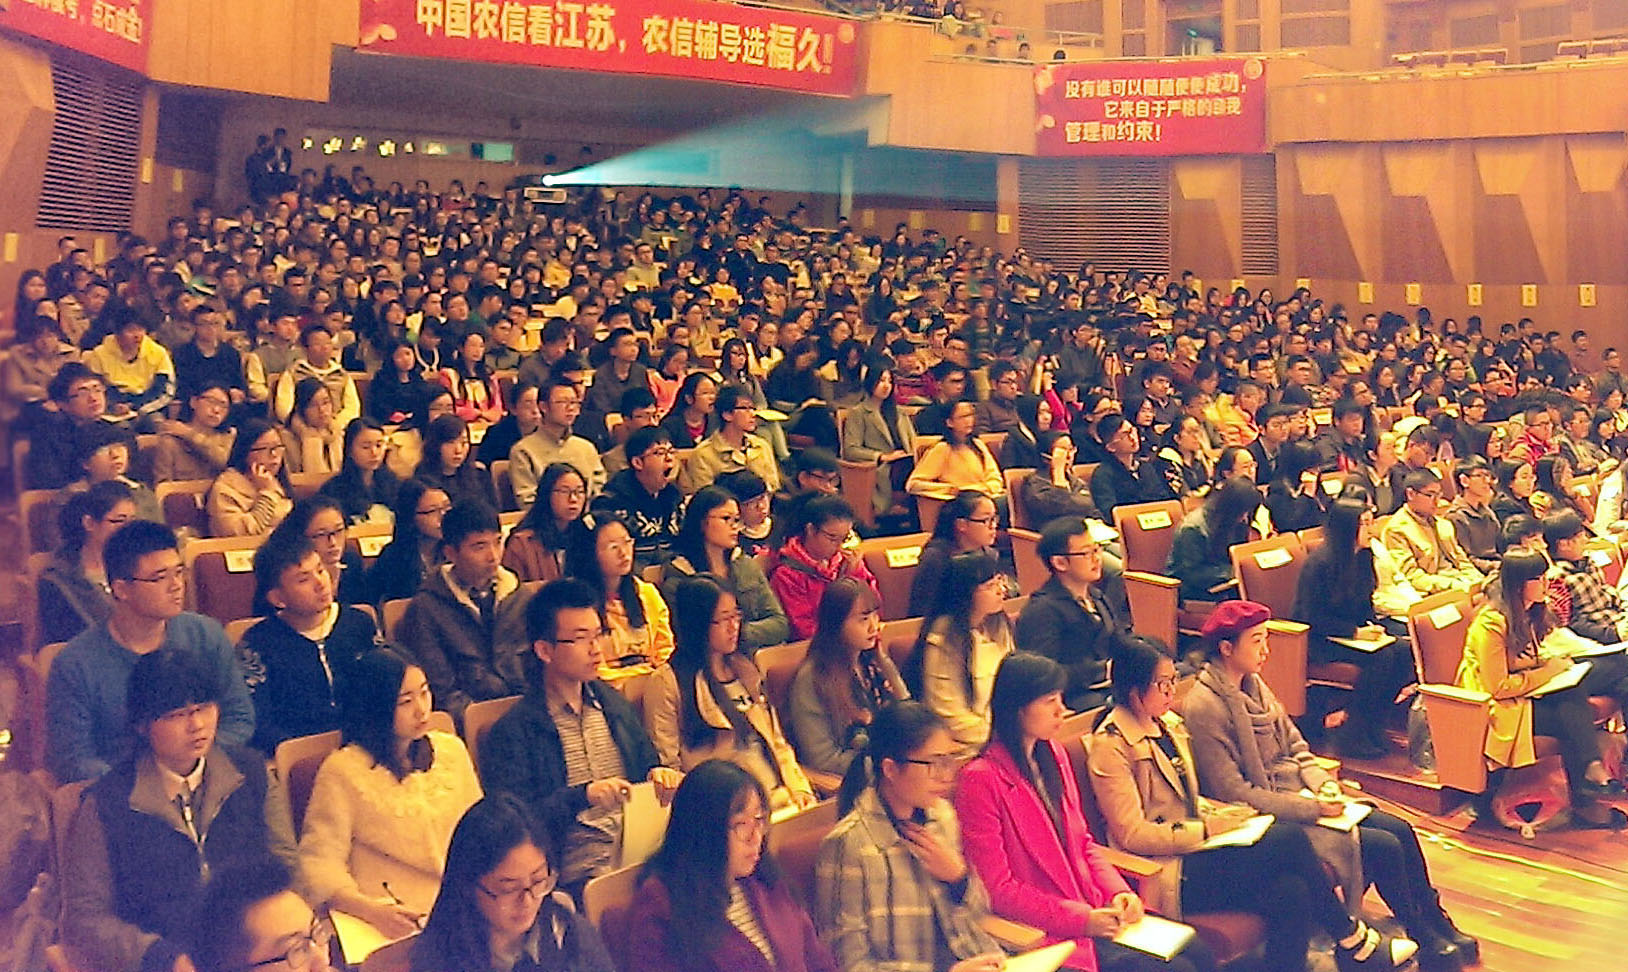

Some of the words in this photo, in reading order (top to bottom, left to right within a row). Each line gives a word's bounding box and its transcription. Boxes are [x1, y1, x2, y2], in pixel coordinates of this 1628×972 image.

[1065, 121, 1162, 142] 管理和约束！
